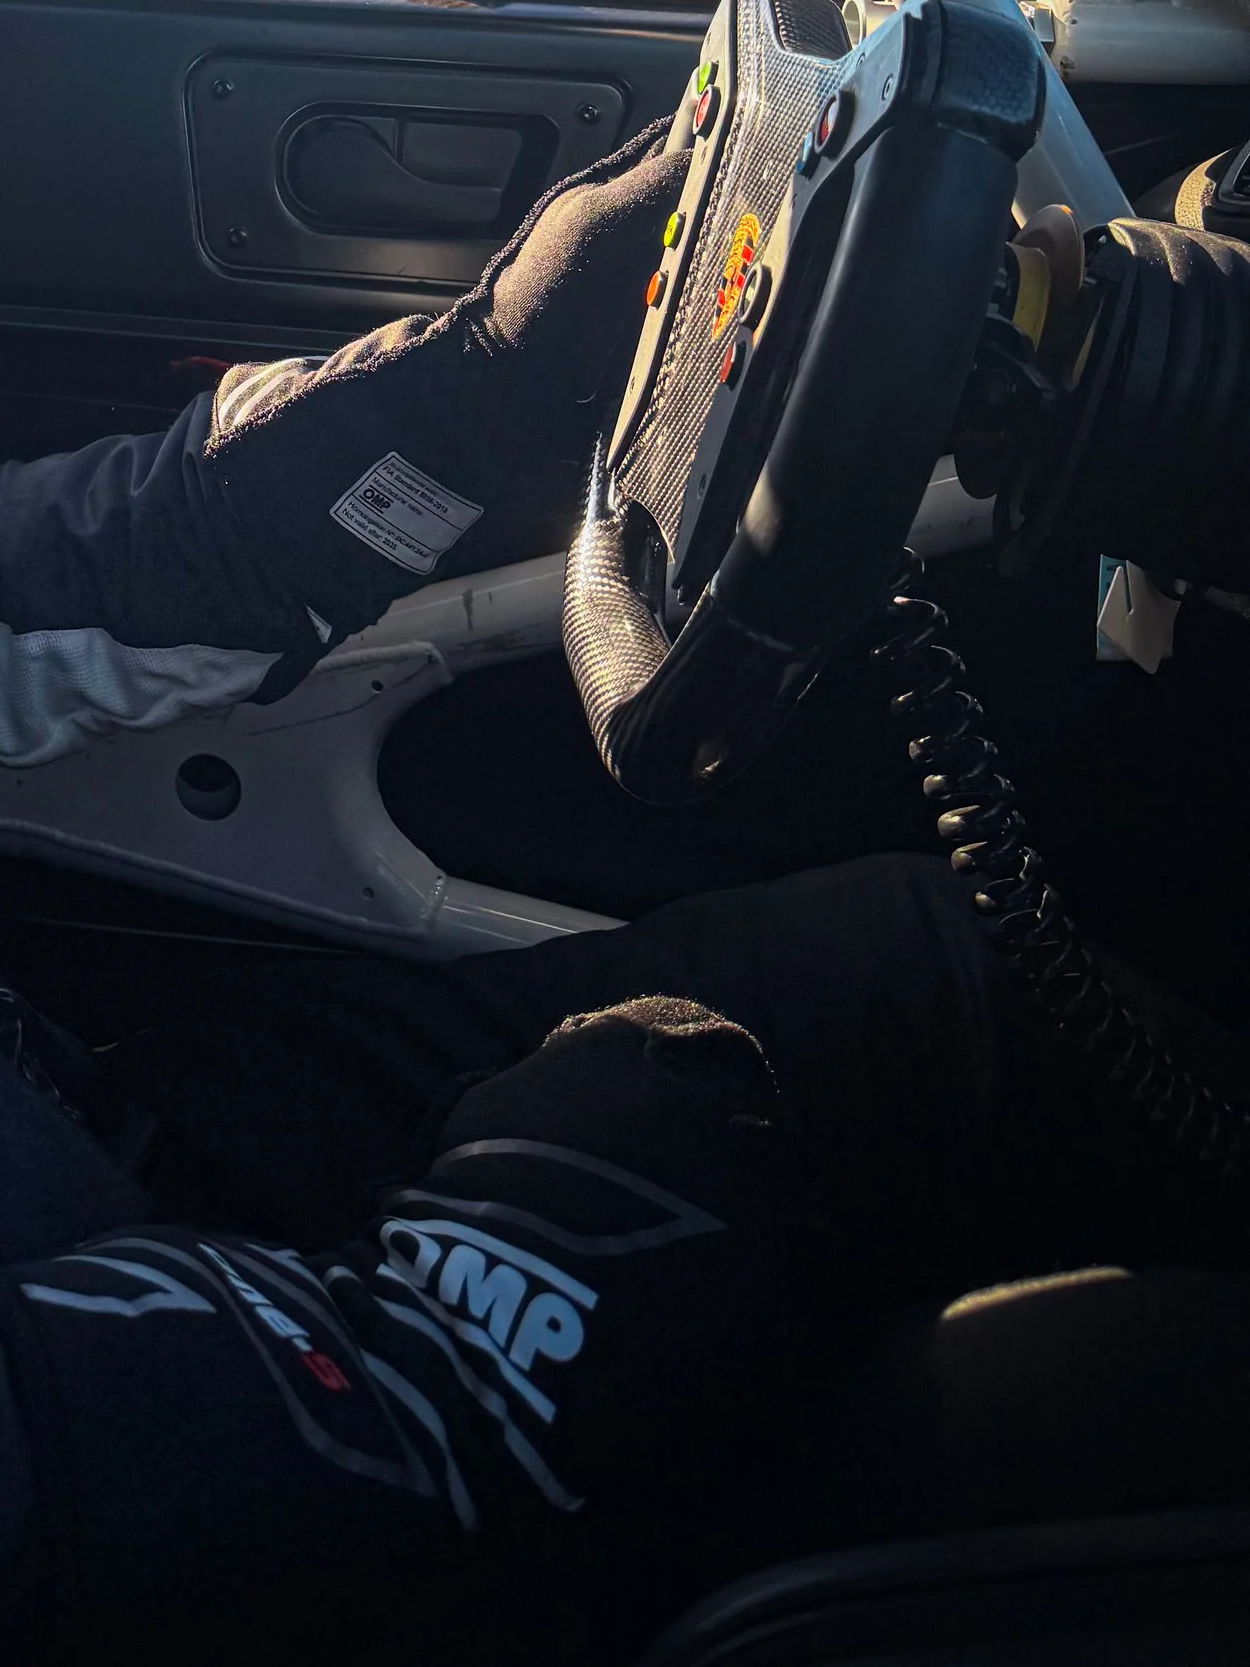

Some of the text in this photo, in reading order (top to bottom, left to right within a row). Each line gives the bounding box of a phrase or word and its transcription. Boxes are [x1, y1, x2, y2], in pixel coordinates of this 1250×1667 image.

[361, 487, 392, 509] OMP
[340, 507, 354, 520] Not
[378, 1220, 586, 1372] OMP
